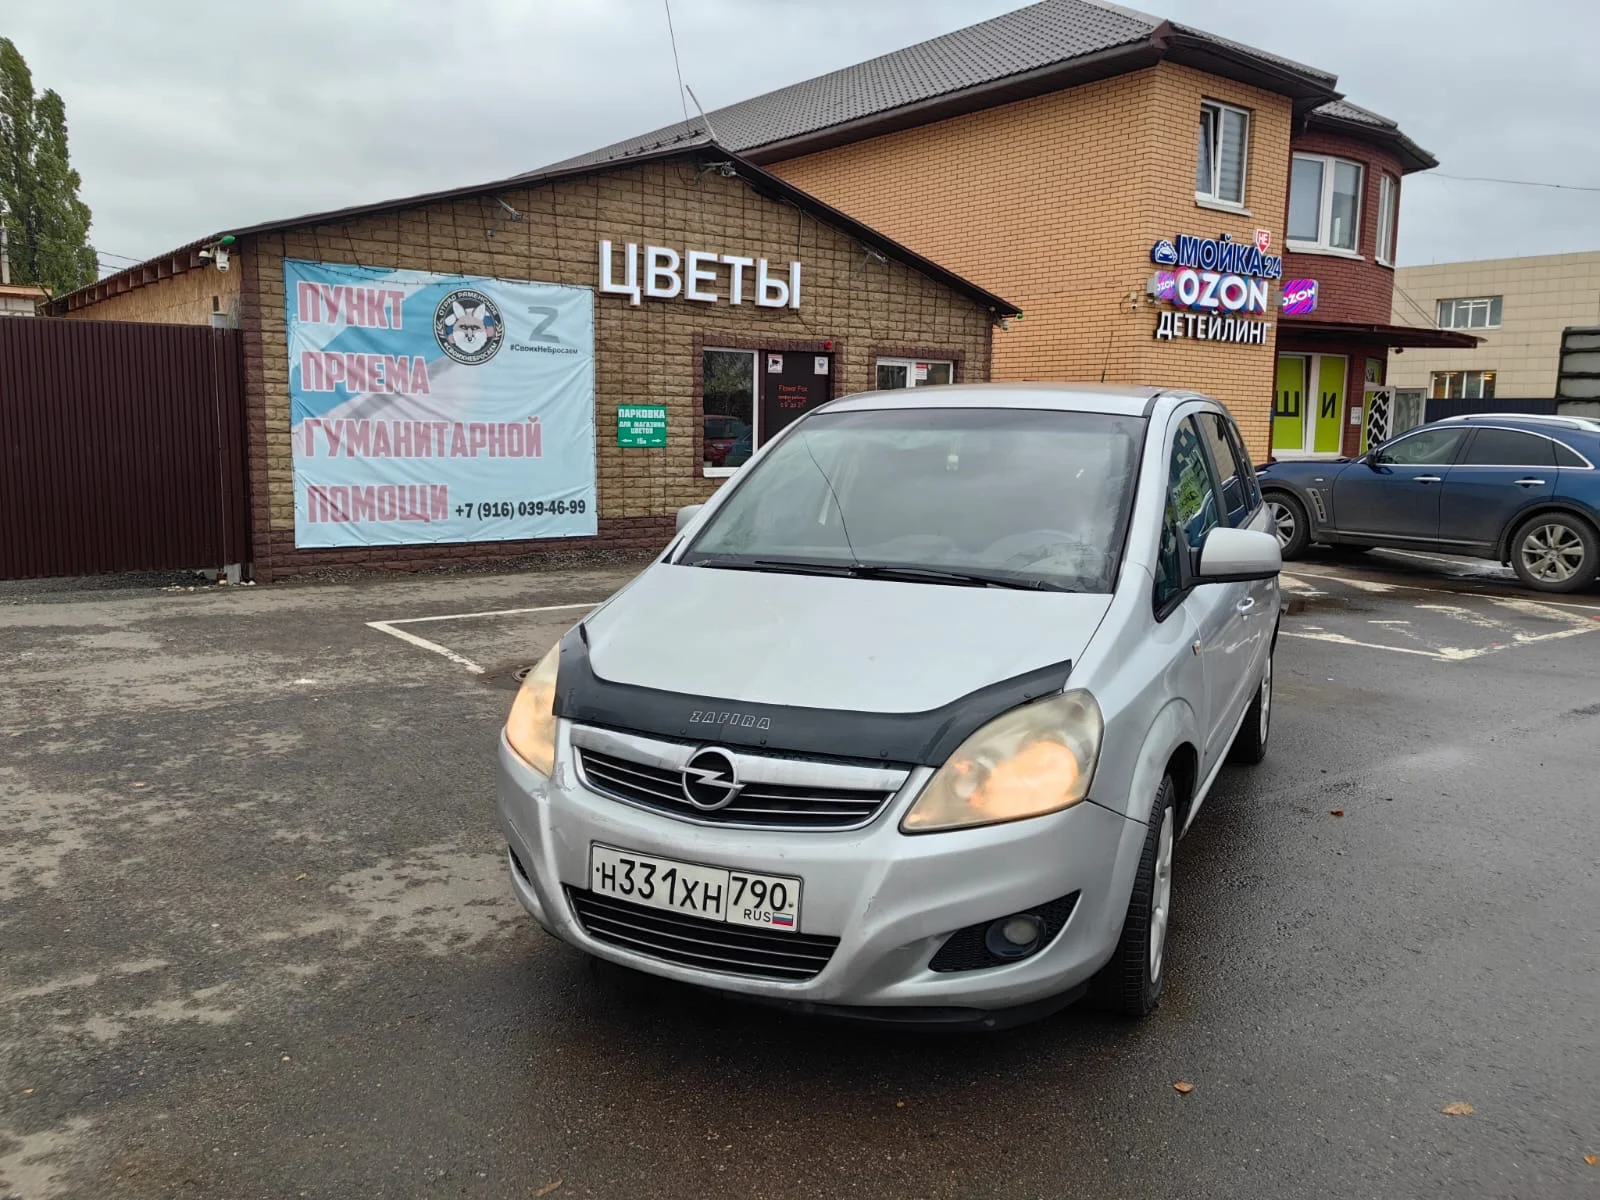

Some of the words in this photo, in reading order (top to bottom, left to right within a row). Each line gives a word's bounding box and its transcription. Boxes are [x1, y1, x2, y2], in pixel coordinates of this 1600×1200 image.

[1257, 231, 1269, 242] НЕ
[1178, 233, 1263, 277] МОЙКА
[1263, 256, 1282, 278] 24
[598, 240, 801, 309] ЦВЕТЫ
[1178, 269, 1268, 313] OZON
[296, 280, 405, 330] ПУНКТ
[1282, 287, 1315, 306] OZON
[528, 306, 560, 343] Z
[1157, 309, 1272, 345] ДЕТЕЙЛИНГ
[301, 350, 430, 395] ПРИЕМА
[618, 408, 666, 419] ПАРКОВКА
[302, 415, 544, 460] ГУМАНИТАРНОЙ
[306, 483, 449, 525] ПОМОЩИ
[455, 502, 474, 519] +7
[477, 500, 514, 521] (916)
[518, 498, 587, 517] 039-46-99
[689, 710, 772, 731] ZAFIRA
[731, 877, 787, 912] 790
[743, 908, 771, 923] RUS
